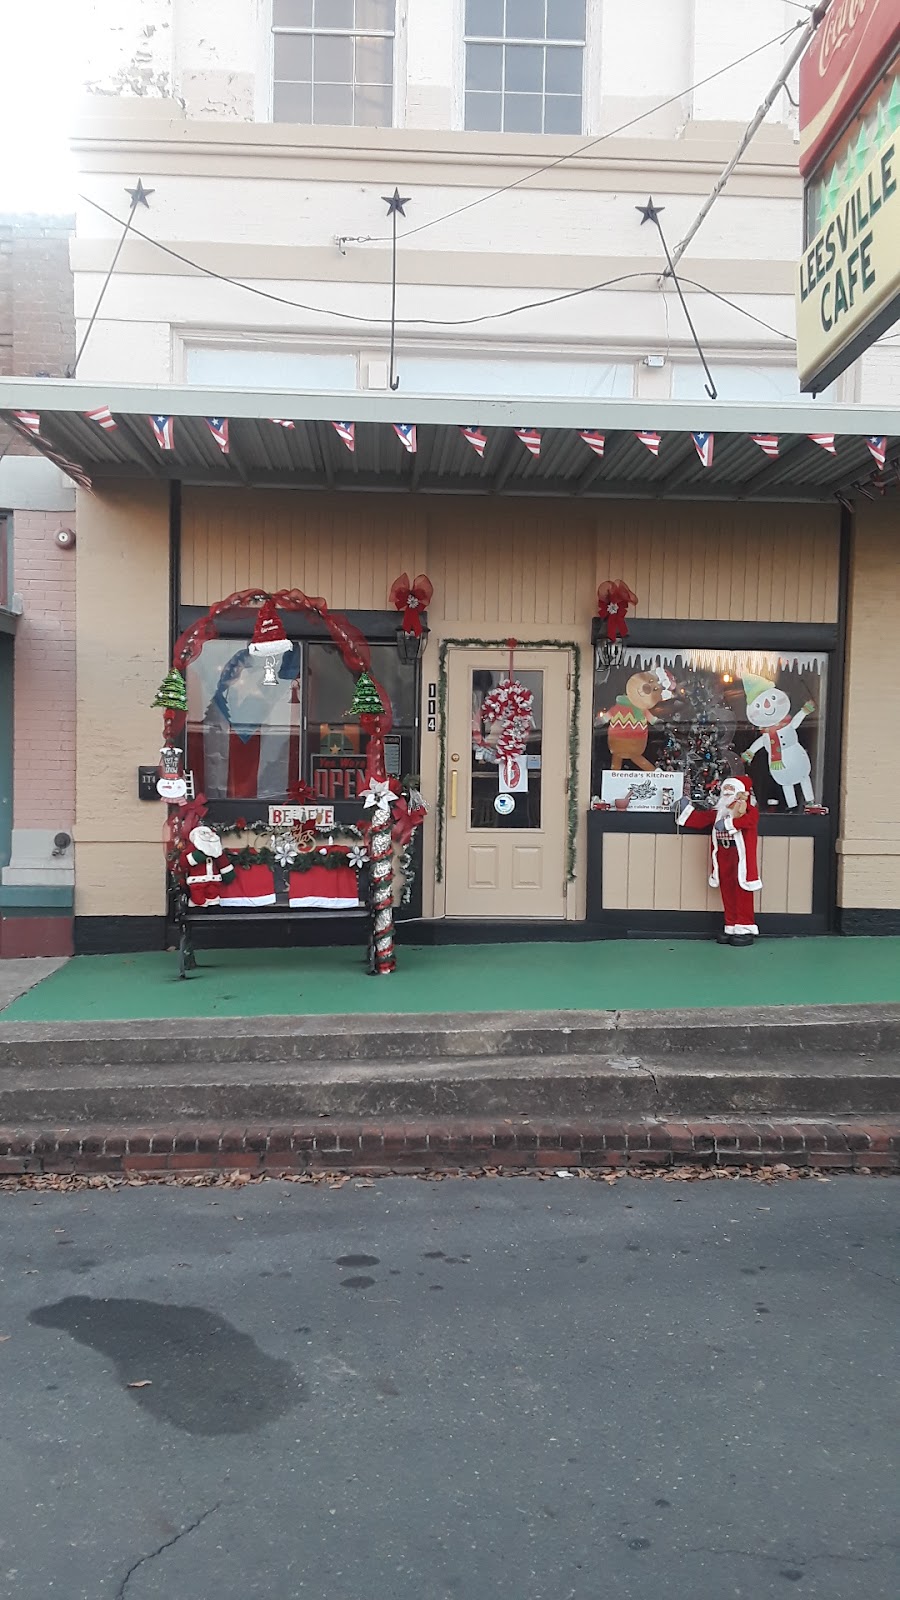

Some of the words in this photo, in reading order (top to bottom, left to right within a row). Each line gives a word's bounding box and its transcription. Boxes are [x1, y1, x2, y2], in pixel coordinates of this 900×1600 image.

[800, 144, 897, 303] LEESVILLE
[820, 230, 876, 333] CAFE
[428, 684, 436, 731] 114
